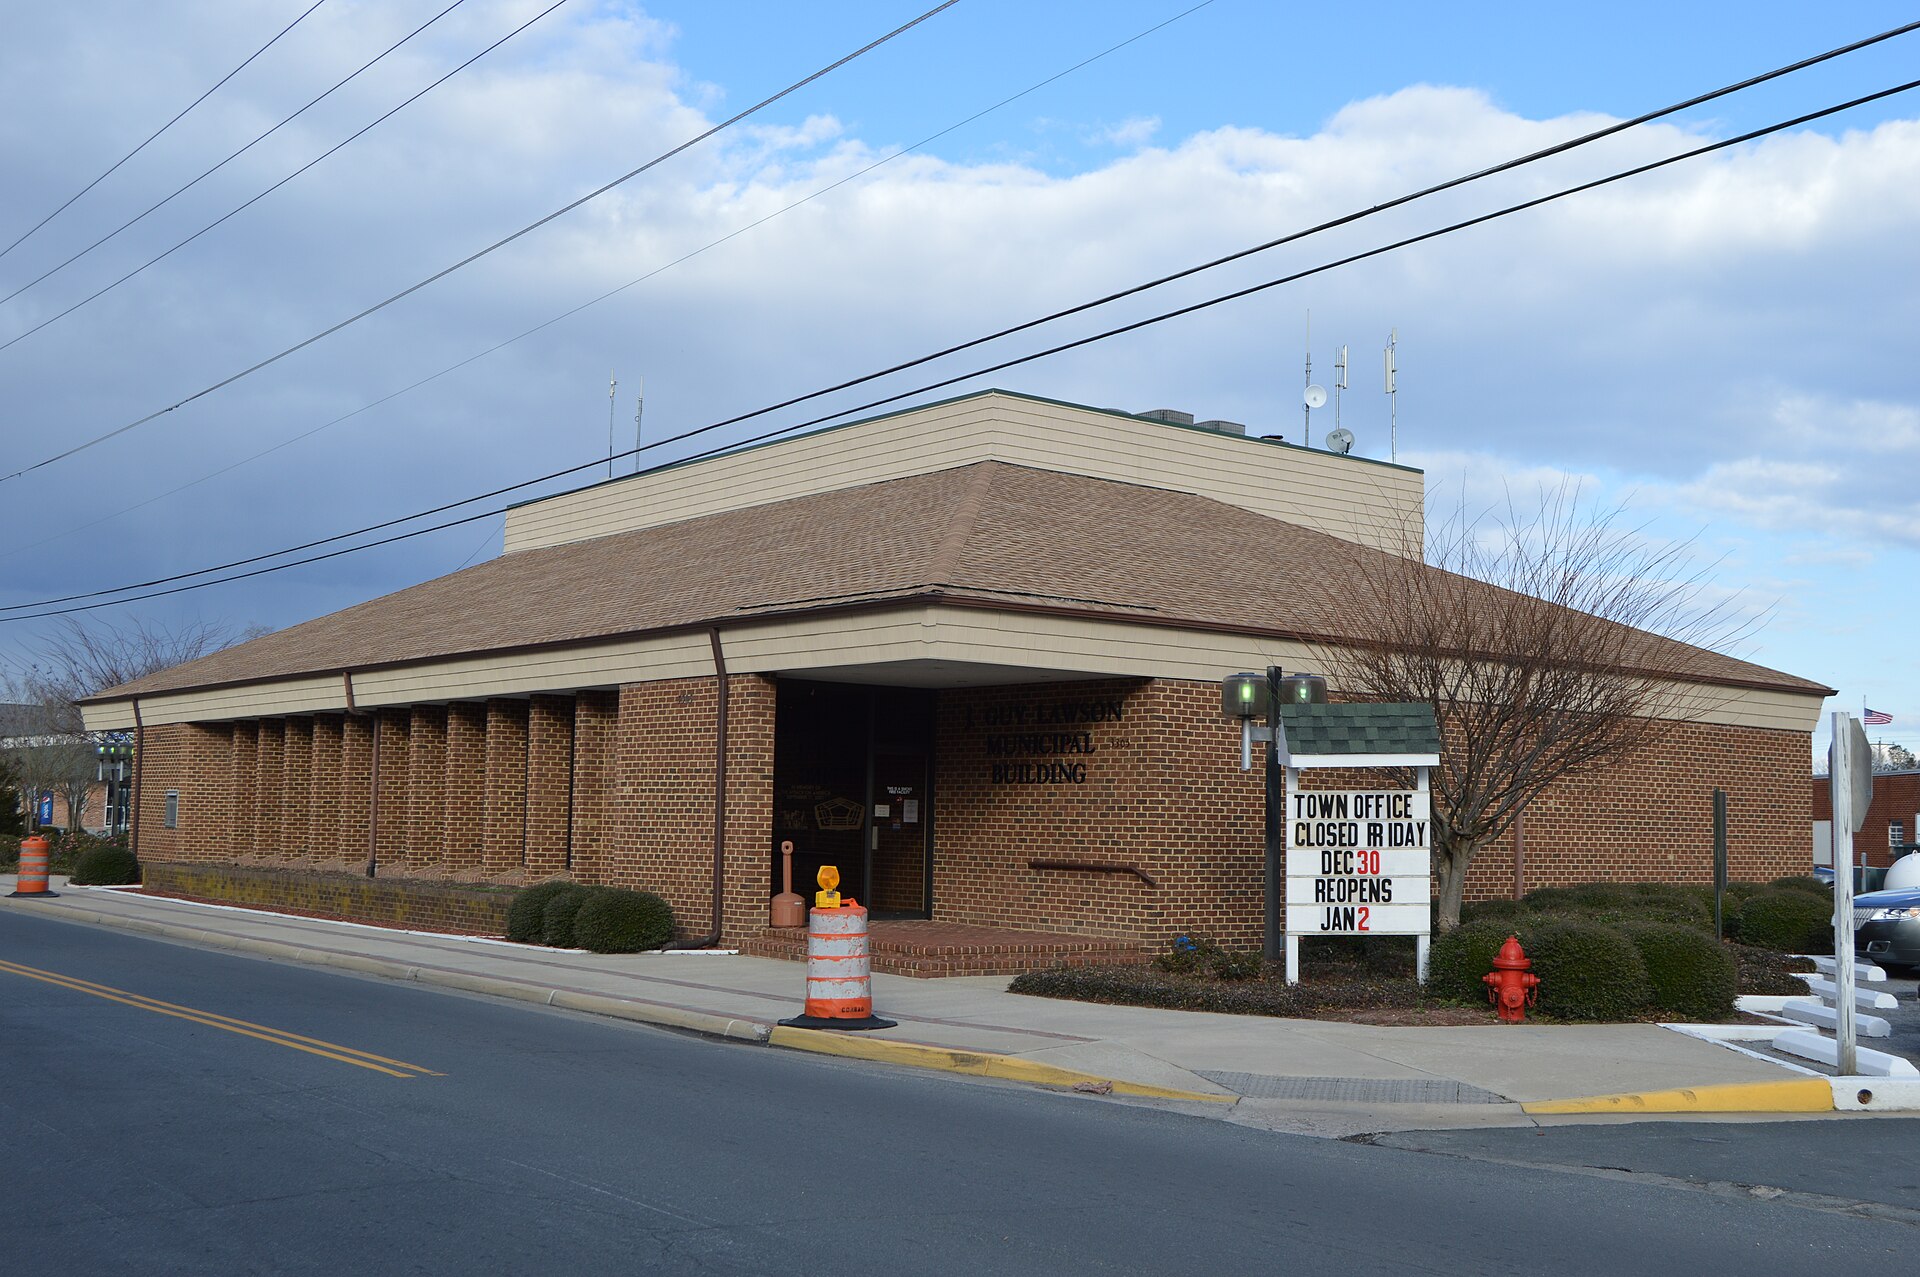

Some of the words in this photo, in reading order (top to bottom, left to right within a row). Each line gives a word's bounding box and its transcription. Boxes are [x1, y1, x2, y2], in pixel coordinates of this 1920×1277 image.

[985, 703, 1027, 725] GUY
[1036, 700, 1123, 724] LAWSON
[986, 733, 1095, 755] MUNICIPAL
[992, 763, 1086, 784] BUILDING
[1294, 794, 1348, 819] TOWN
[1353, 794, 1413, 819] OFFICE
[1294, 822, 1358, 847] CLOSED
[1321, 850, 1354, 875] DEC
[1357, 850, 1380, 875] 30
[1315, 878, 1392, 903] REOPENS
[1320, 906, 1355, 931] JAN
[1357, 906, 1370, 931] 2
